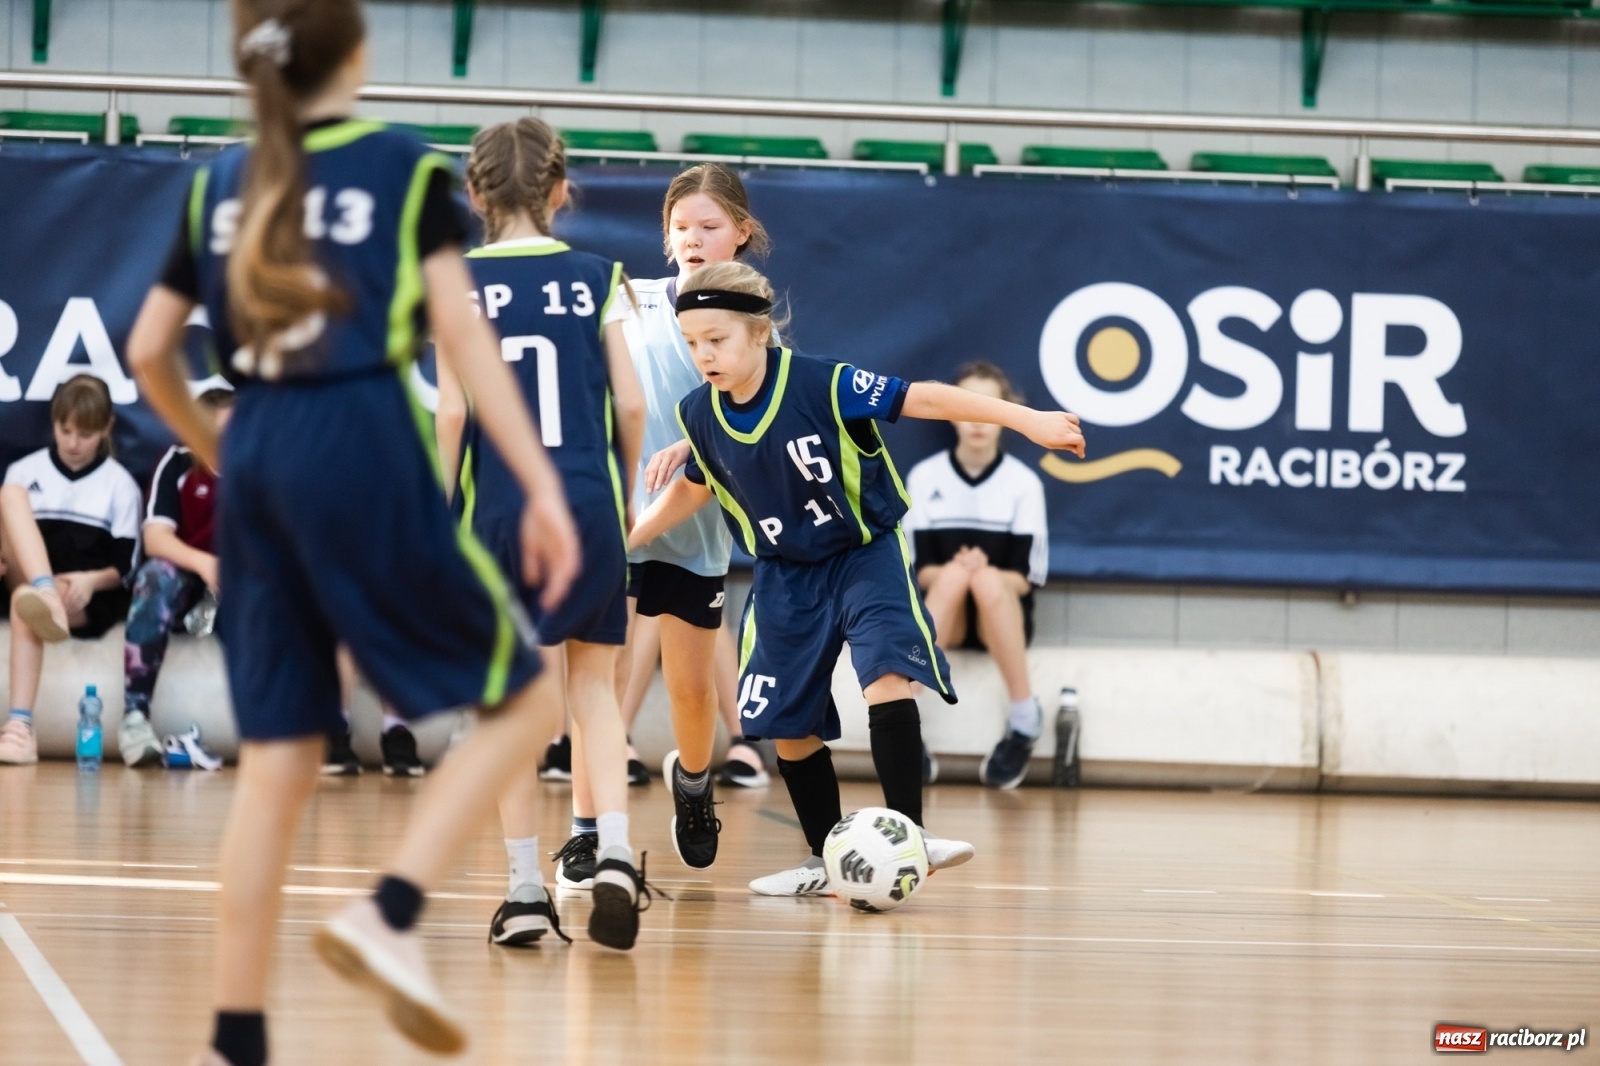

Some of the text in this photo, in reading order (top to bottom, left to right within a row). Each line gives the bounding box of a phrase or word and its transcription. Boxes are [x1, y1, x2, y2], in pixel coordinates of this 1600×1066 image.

[303, 186, 374, 245] 13
[541, 280, 596, 317] 13
[1038, 281, 1468, 438] OSiR
[500, 334, 563, 448] 7
[786, 433, 833, 484] 15
[1209, 438, 1468, 492] RACIBÓRZ
[803, 495, 844, 528] 1
[736, 673, 777, 720] 15
